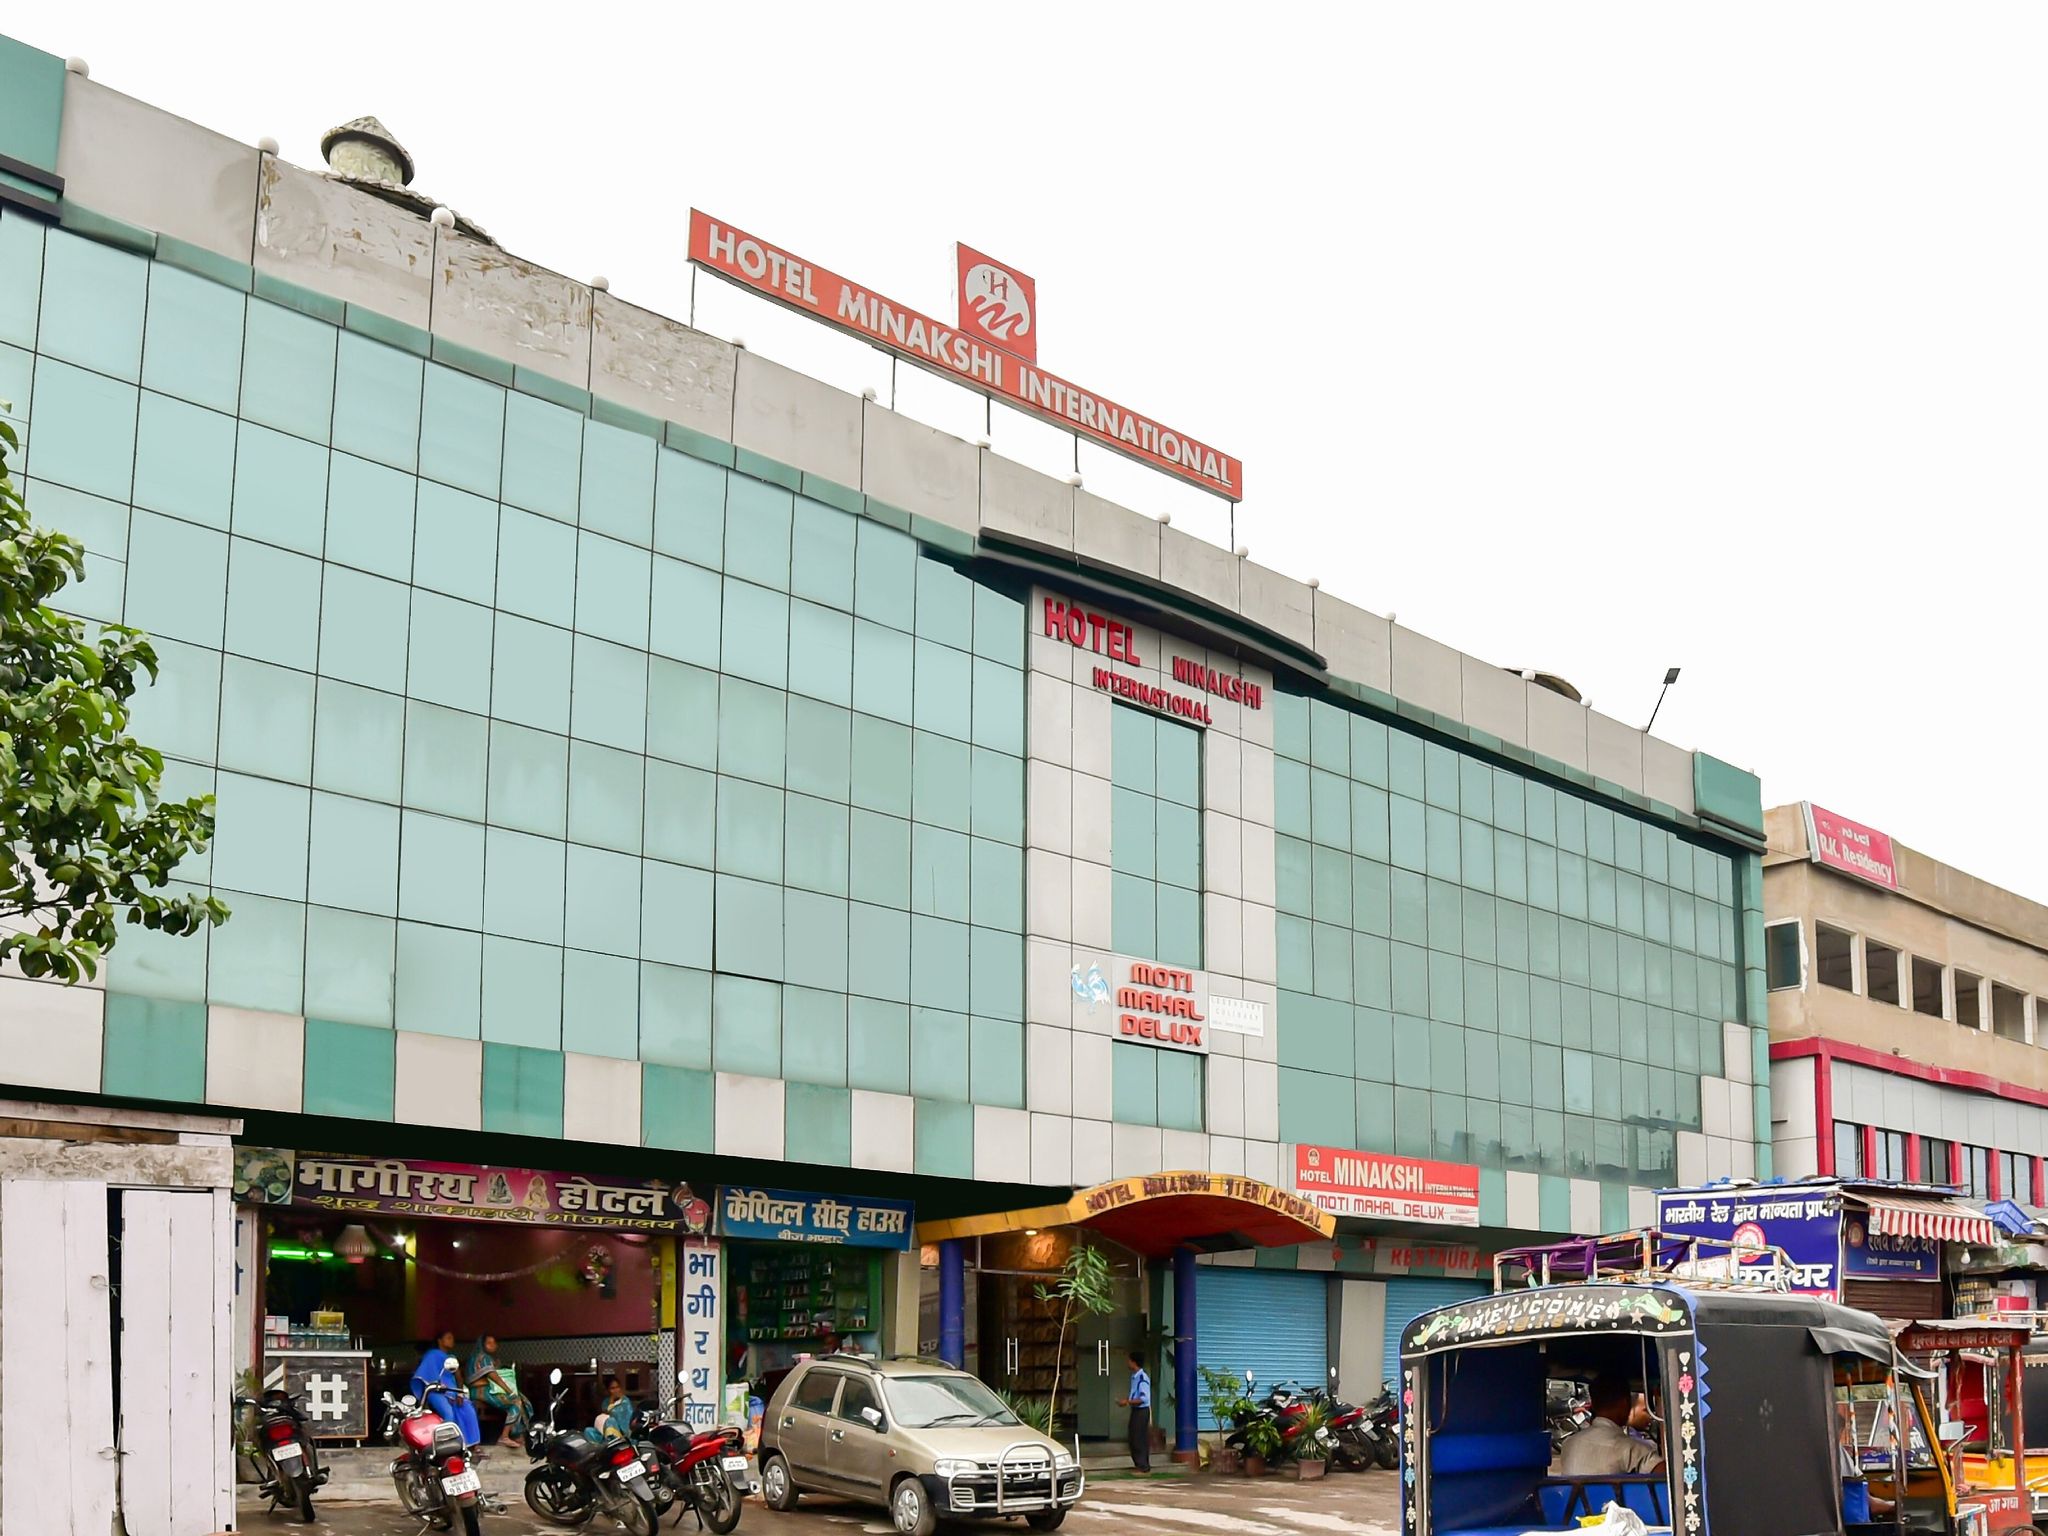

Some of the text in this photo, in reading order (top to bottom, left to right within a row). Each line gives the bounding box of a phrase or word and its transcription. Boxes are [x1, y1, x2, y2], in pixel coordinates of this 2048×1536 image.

[708, 223, 1233, 486] HOTEL MINAKSHI INTERNATIONAL
[1044, 597, 1262, 710] HOTEL MINAKSHI
[1093, 667, 1213, 725] INTERNATIONAL
[1842, 843, 1891, 883] Residency
[1131, 963, 1193, 992] MOTI
[1118, 987, 1205, 1021] MAHAL
[1120, 1014, 1202, 1046] DELUX
[299, 1159, 669, 1216] भागीरथ होटल
[1300, 1157, 1476, 1198] HOTEL MINAKSHI INTERNATIONAL
[725, 1189, 806, 1227] कैपिटल
[857, 1207, 907, 1233] हाउस
[1086, 1182, 1135, 1213] HOTEL
[1316, 1194, 1349, 1211] MOTI
[1354, 1198, 1399, 1216] MAHAL
[1404, 1203, 1445, 1220] DELUX
[1665, 1201, 1706, 1223] भारतीय
[1711, 1200, 1730, 1223] रेल
[1760, 1201, 1803, 1220] मान्यता
[545, 1211, 679, 1230] भोजनालय
[1391, 1247, 1494, 1270] RESTAURAN
